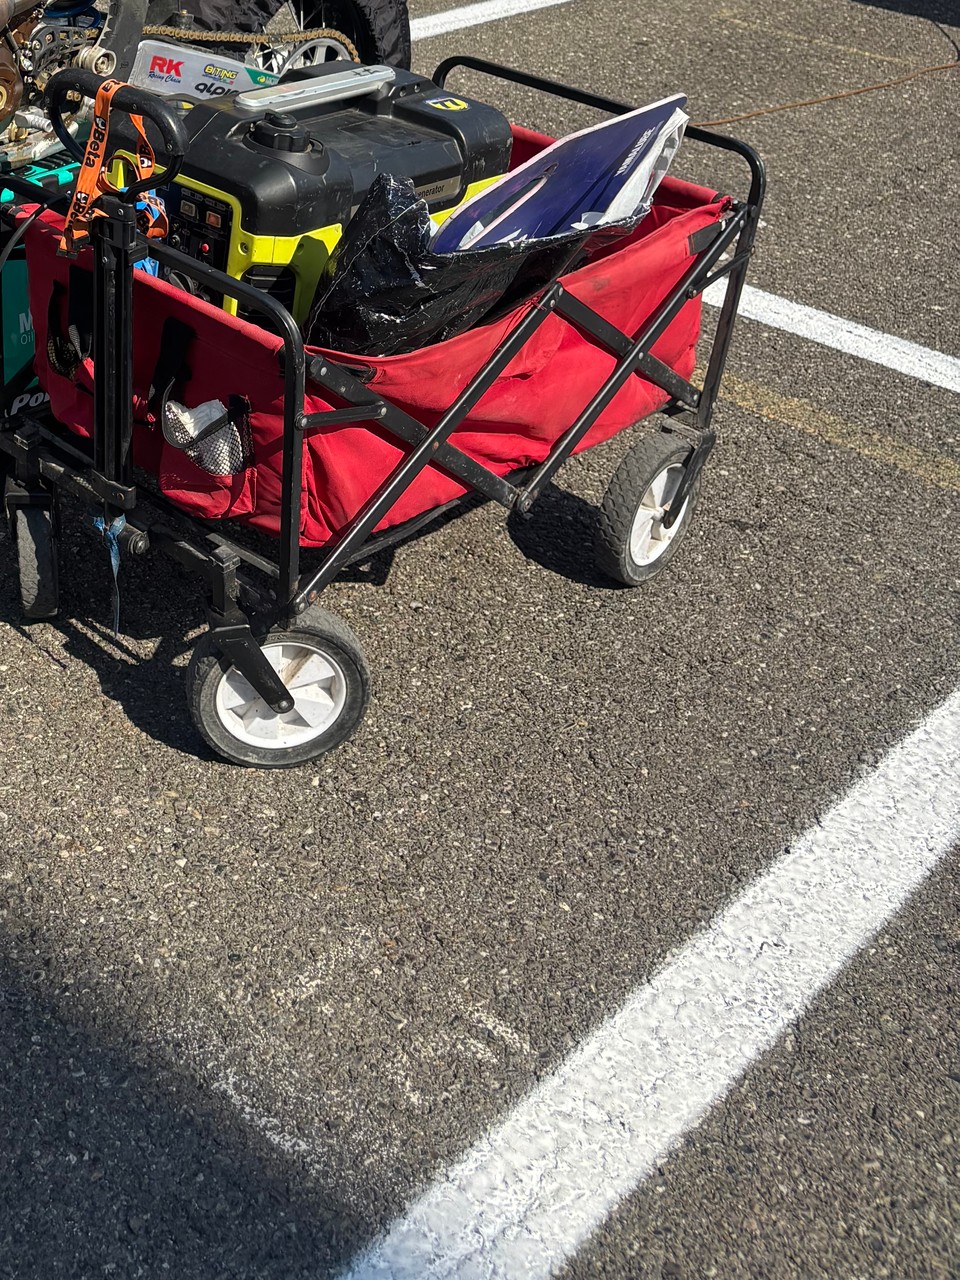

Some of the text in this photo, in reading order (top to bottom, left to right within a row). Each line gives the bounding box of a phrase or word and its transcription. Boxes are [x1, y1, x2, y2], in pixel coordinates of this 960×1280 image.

[149, 55, 185, 78] RK
[204, 64, 238, 80] BITING
[147, 71, 181, 84] Racing Chain
[85, 130, 105, 168] Beta
